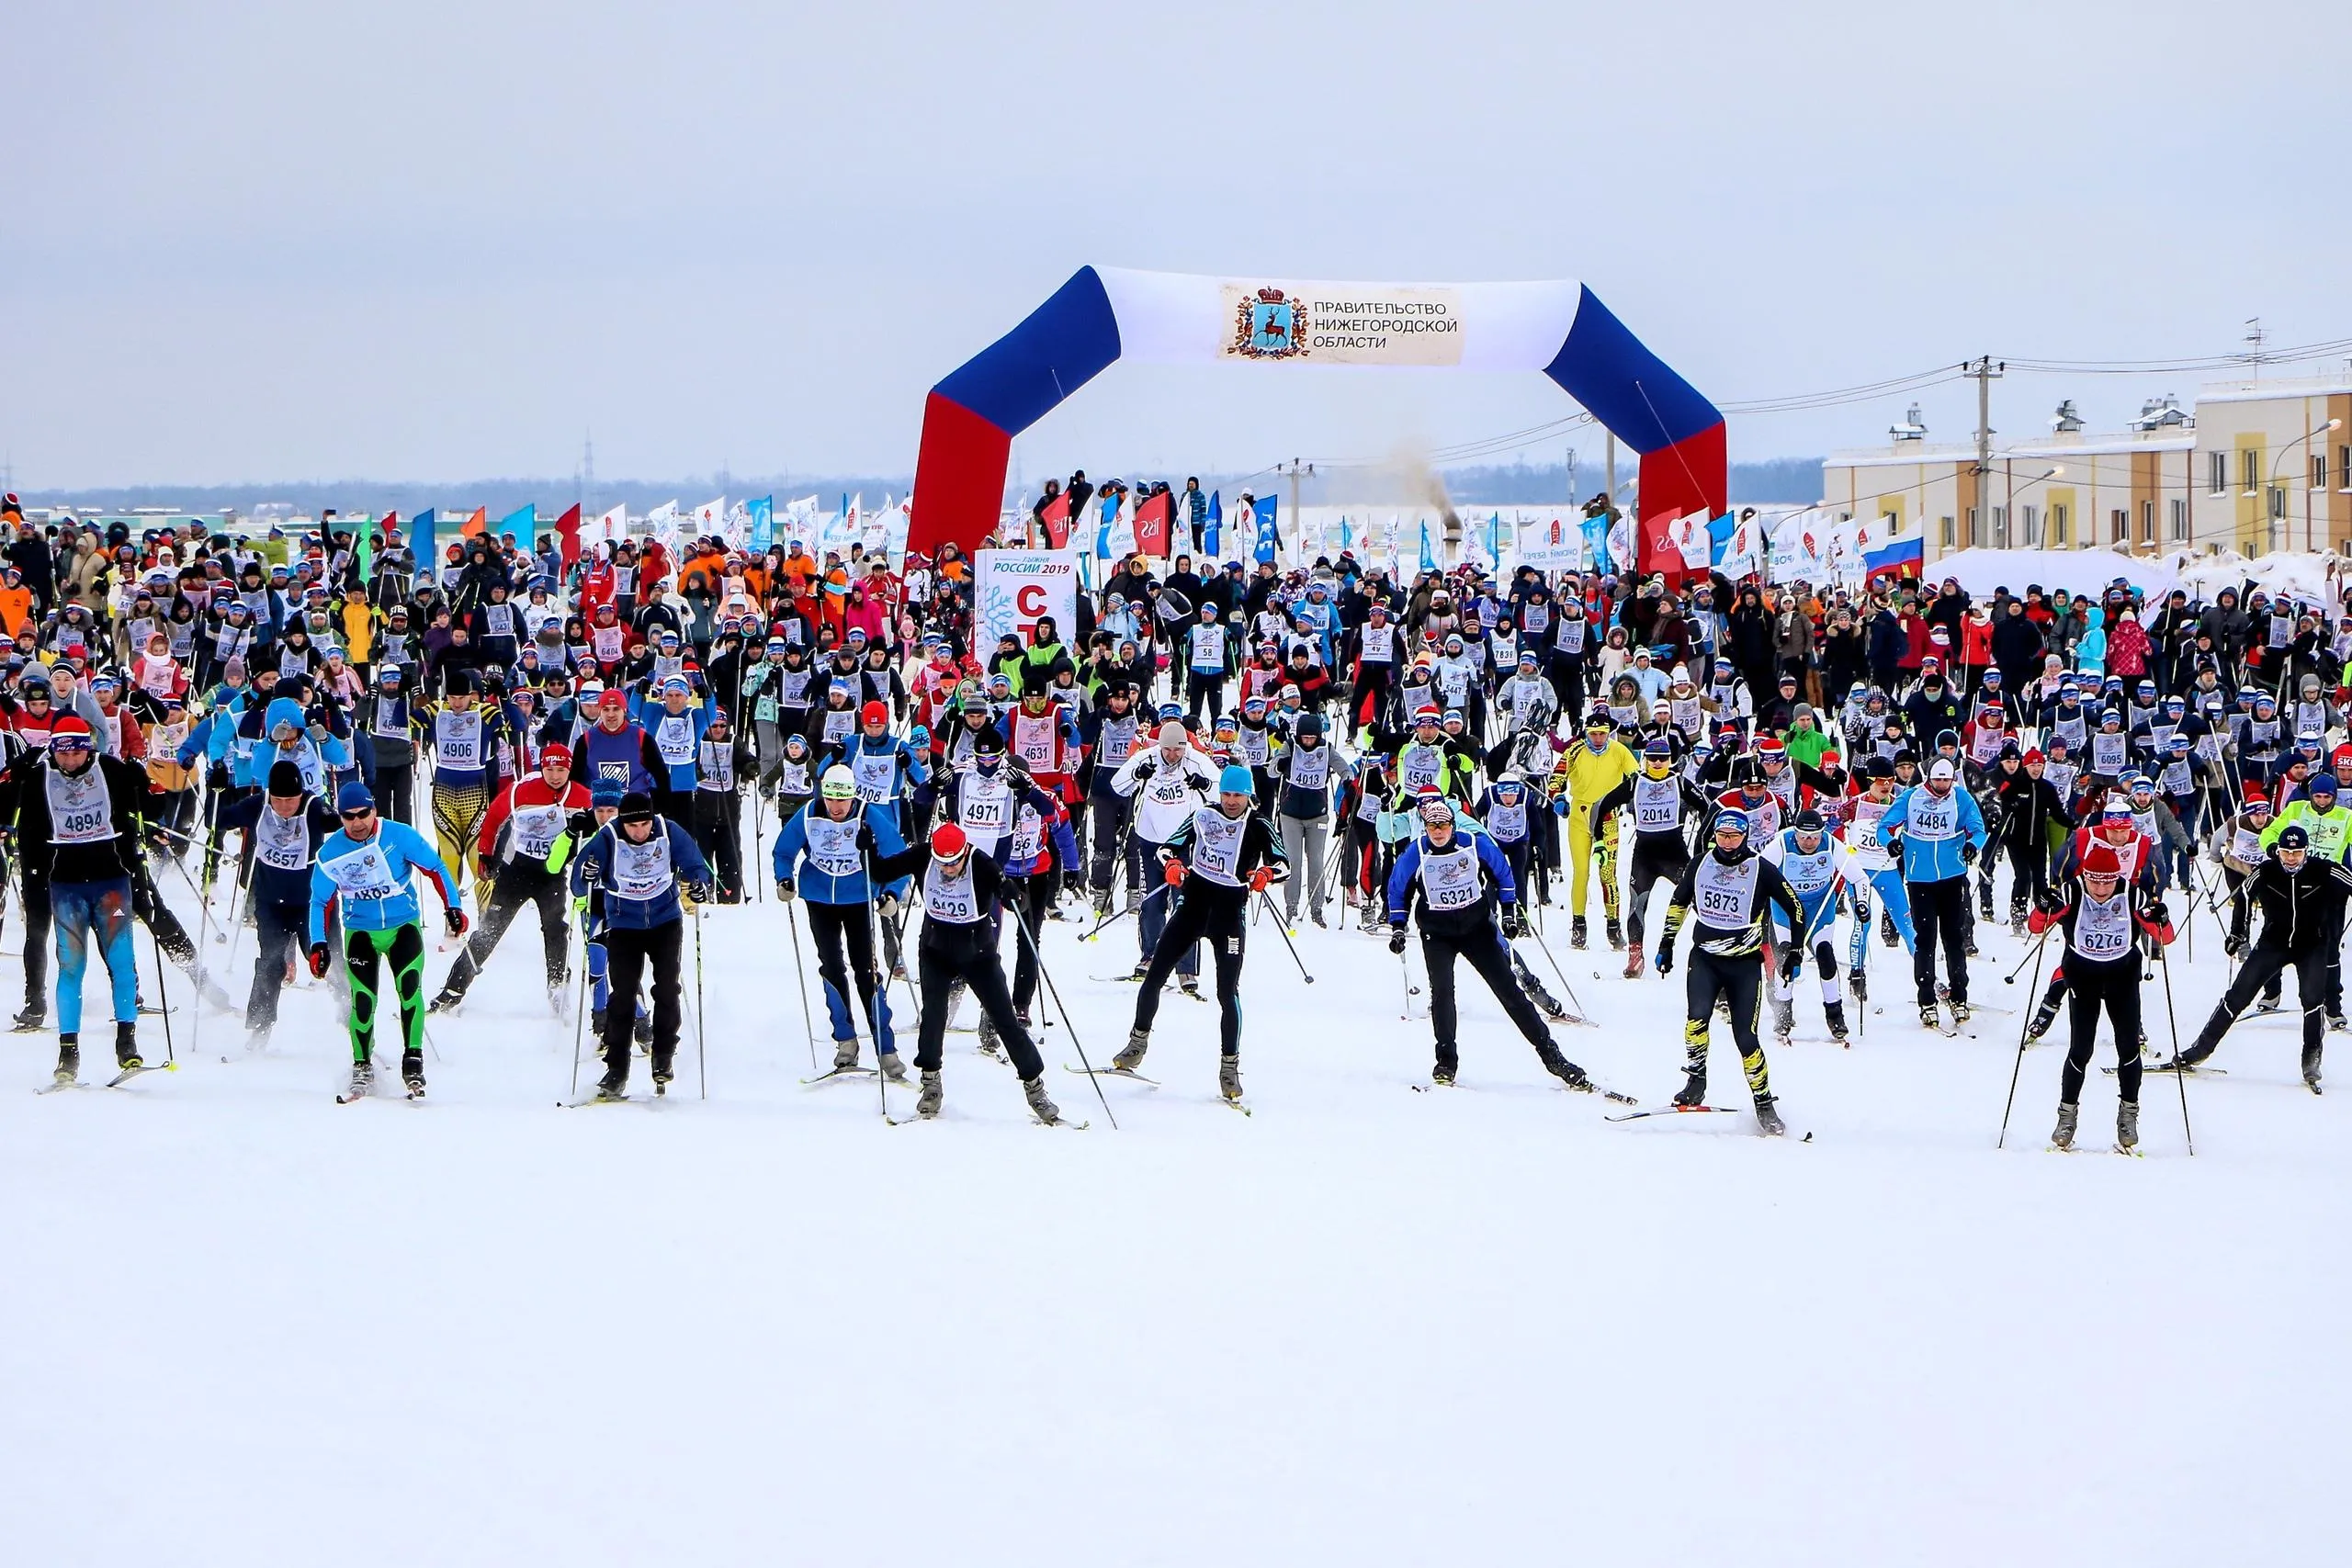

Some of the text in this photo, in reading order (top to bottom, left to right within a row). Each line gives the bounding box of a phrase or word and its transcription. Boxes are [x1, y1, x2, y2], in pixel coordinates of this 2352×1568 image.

[1315, 301, 1447, 315] ПРАВИТЕЛЬСТВО
[1315, 318, 1457, 333] НИЖЕГОРОДСКОЙ
[1313, 336, 1386, 348] ОБЛАСТИ
[993, 562, 1070, 575] РОССИИ 2019
[1203, 649, 1213, 657] 58
[1445, 684, 1463, 695] 5447
[443, 742, 473, 758] 4906
[1024, 747, 1049, 761] 4631
[2100, 754, 2123, 765] 6095
[1295, 773, 1319, 785] 4013
[1408, 770, 1433, 786] 4549
[1155, 784, 1184, 801] 4605
[967, 803, 1000, 821] 4971
[1642, 807, 1671, 821] 2014
[64, 809, 103, 833] 4894
[1916, 812, 1949, 830] 4484
[526, 840, 554, 856] 445
[264, 848, 300, 868] 4557
[1440, 886, 1474, 906] 6321
[1703, 891, 1740, 914] 5873
[1227, 936, 1239, 955] SWIX
[2087, 933, 2123, 950] 6276
